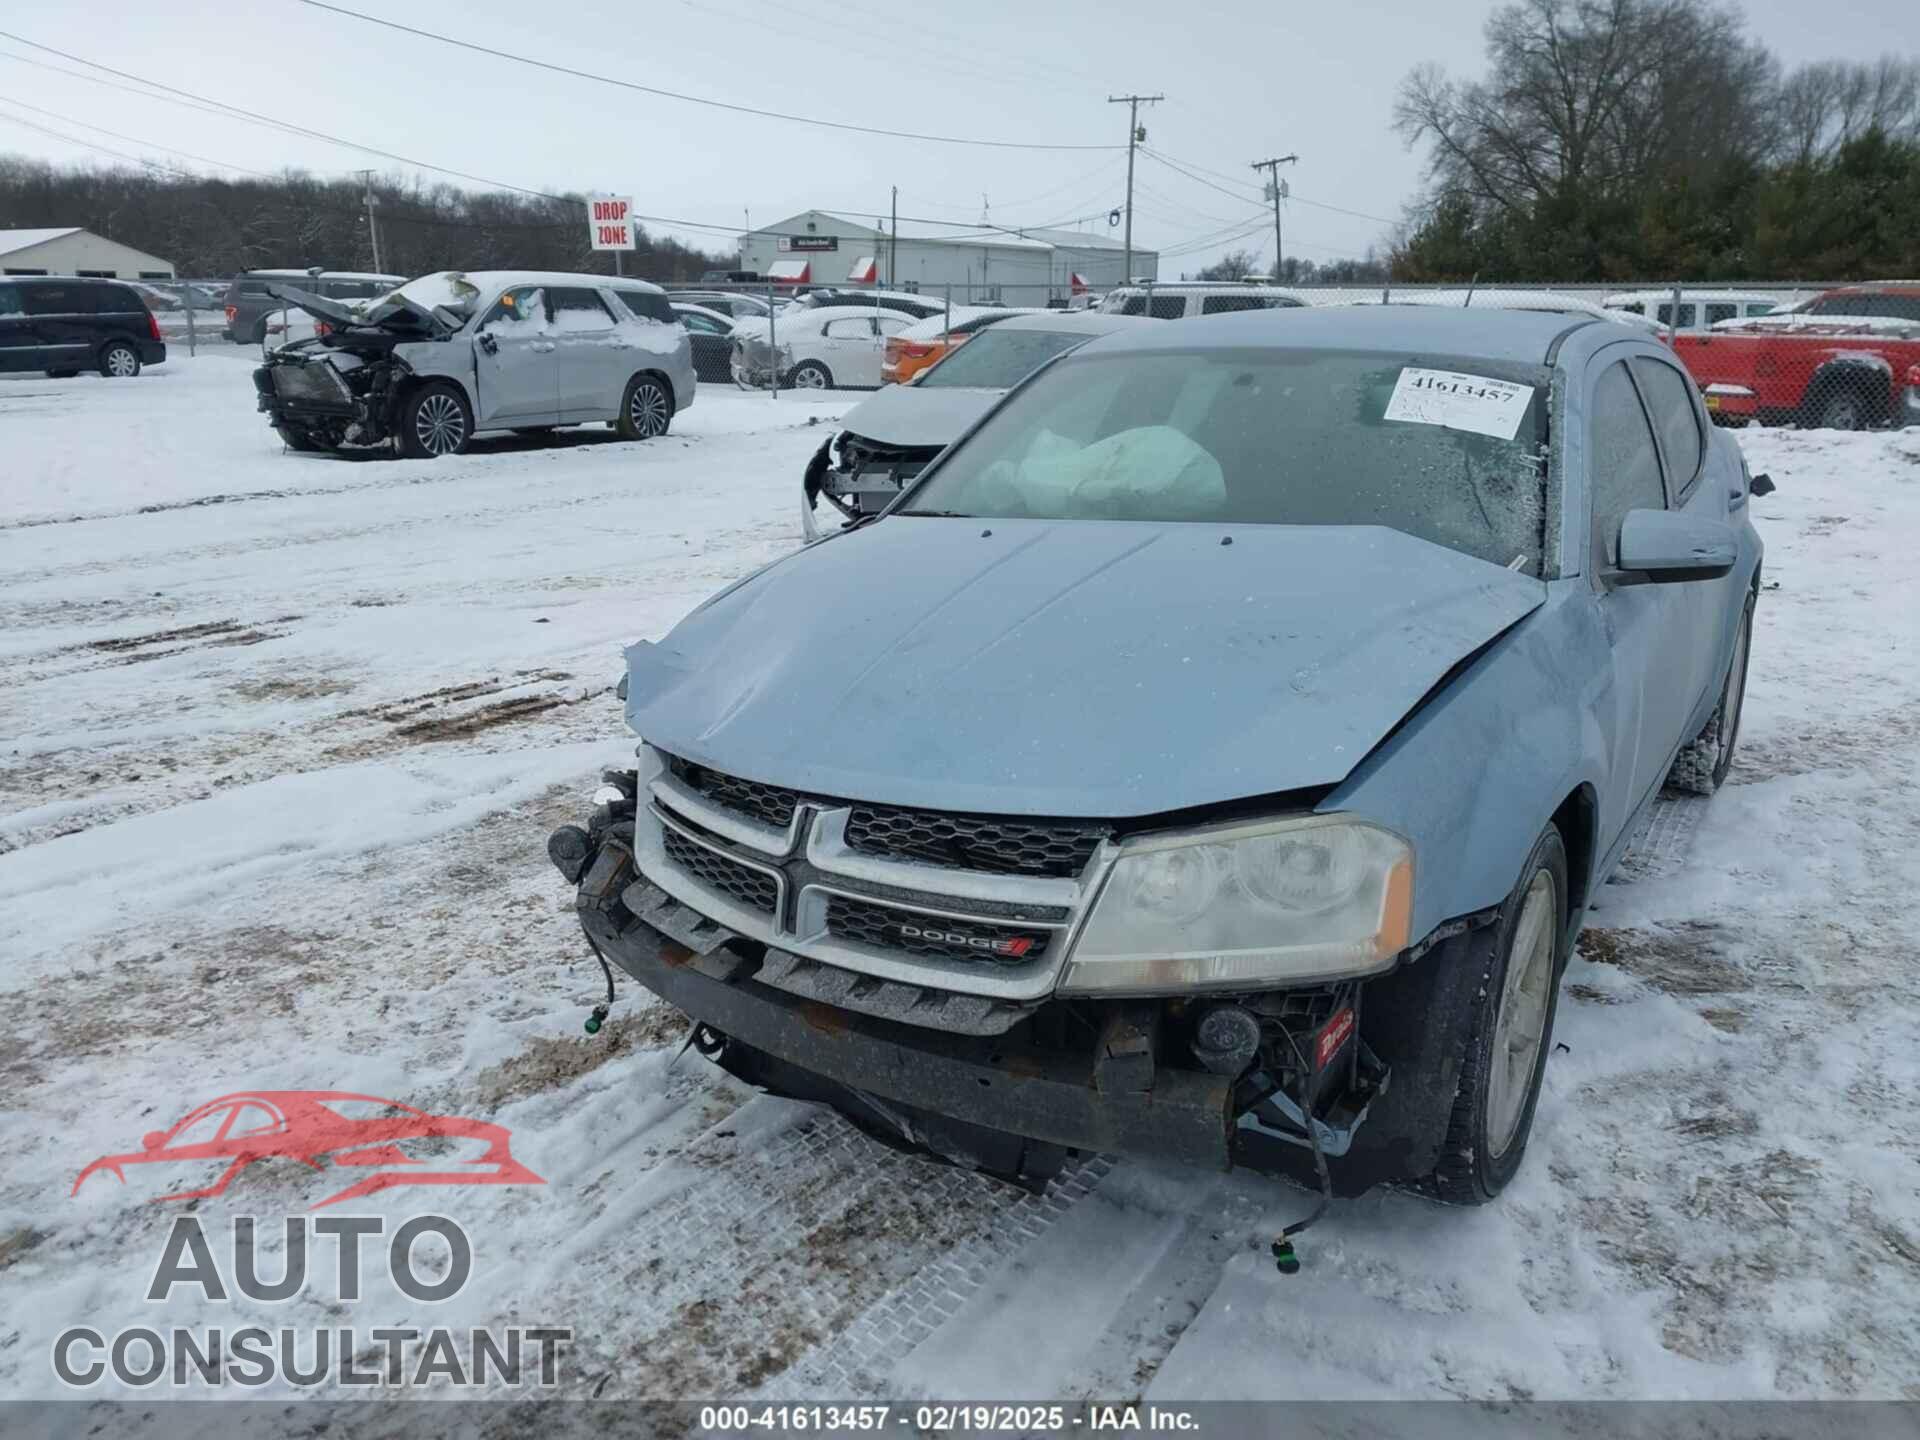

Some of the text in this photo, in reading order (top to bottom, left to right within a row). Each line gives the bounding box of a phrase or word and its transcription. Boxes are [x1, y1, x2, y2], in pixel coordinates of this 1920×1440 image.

[593, 201, 627, 220] DROP
[597, 226, 627, 244] ZONE
[1411, 376, 1514, 403] 41613457
[901, 925, 1013, 952] DODGE
